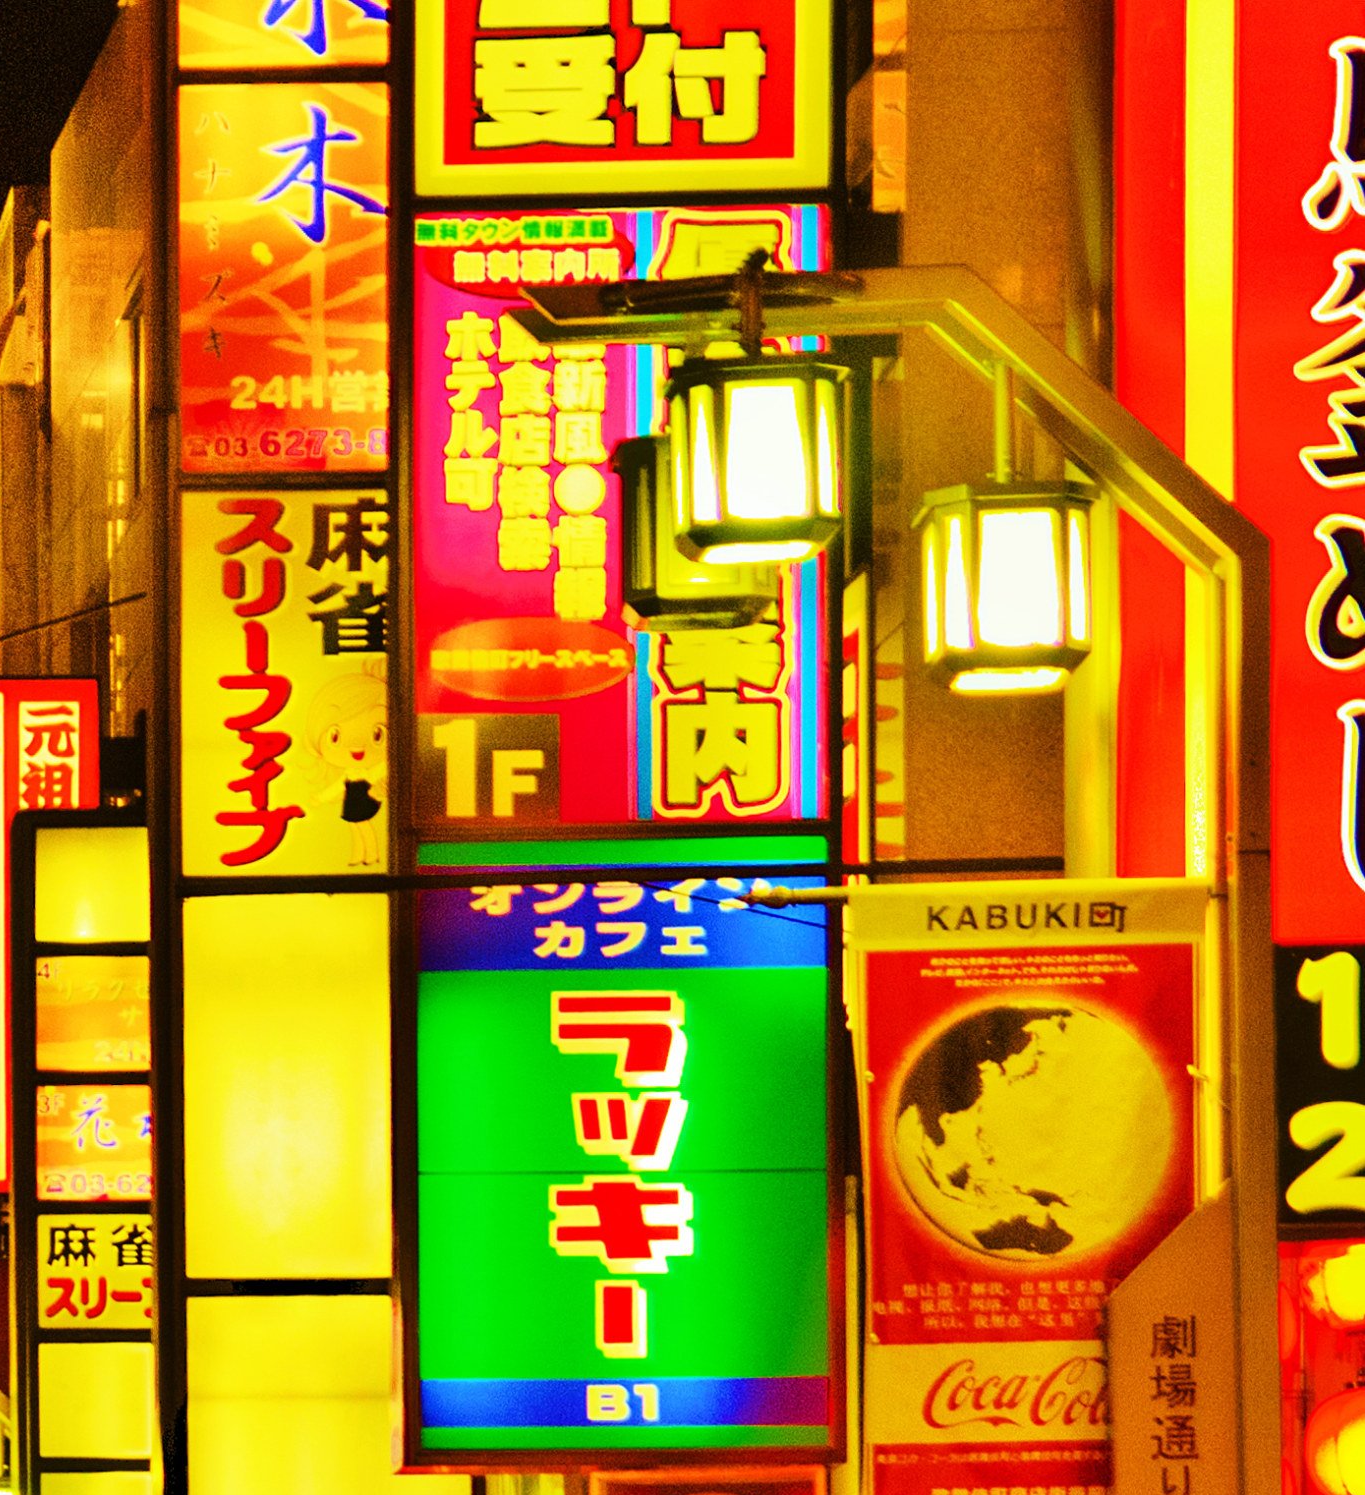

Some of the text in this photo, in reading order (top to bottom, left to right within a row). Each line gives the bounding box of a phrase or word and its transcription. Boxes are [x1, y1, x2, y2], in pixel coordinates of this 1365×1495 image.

[475, 32, 766, 148] 受付
[258, 106, 387, 243] 木
[454, 250, 620, 282] 無料案内所
[21, 703, 76, 809] 元祖
[433, 719, 544, 817] 1F
[534, 921, 707, 958] カフェ
[552, 991, 692, 1357] ラッキー
[47, 1224, 151, 1268] 麻雀
[587, 1384, 660, 1420] B1
